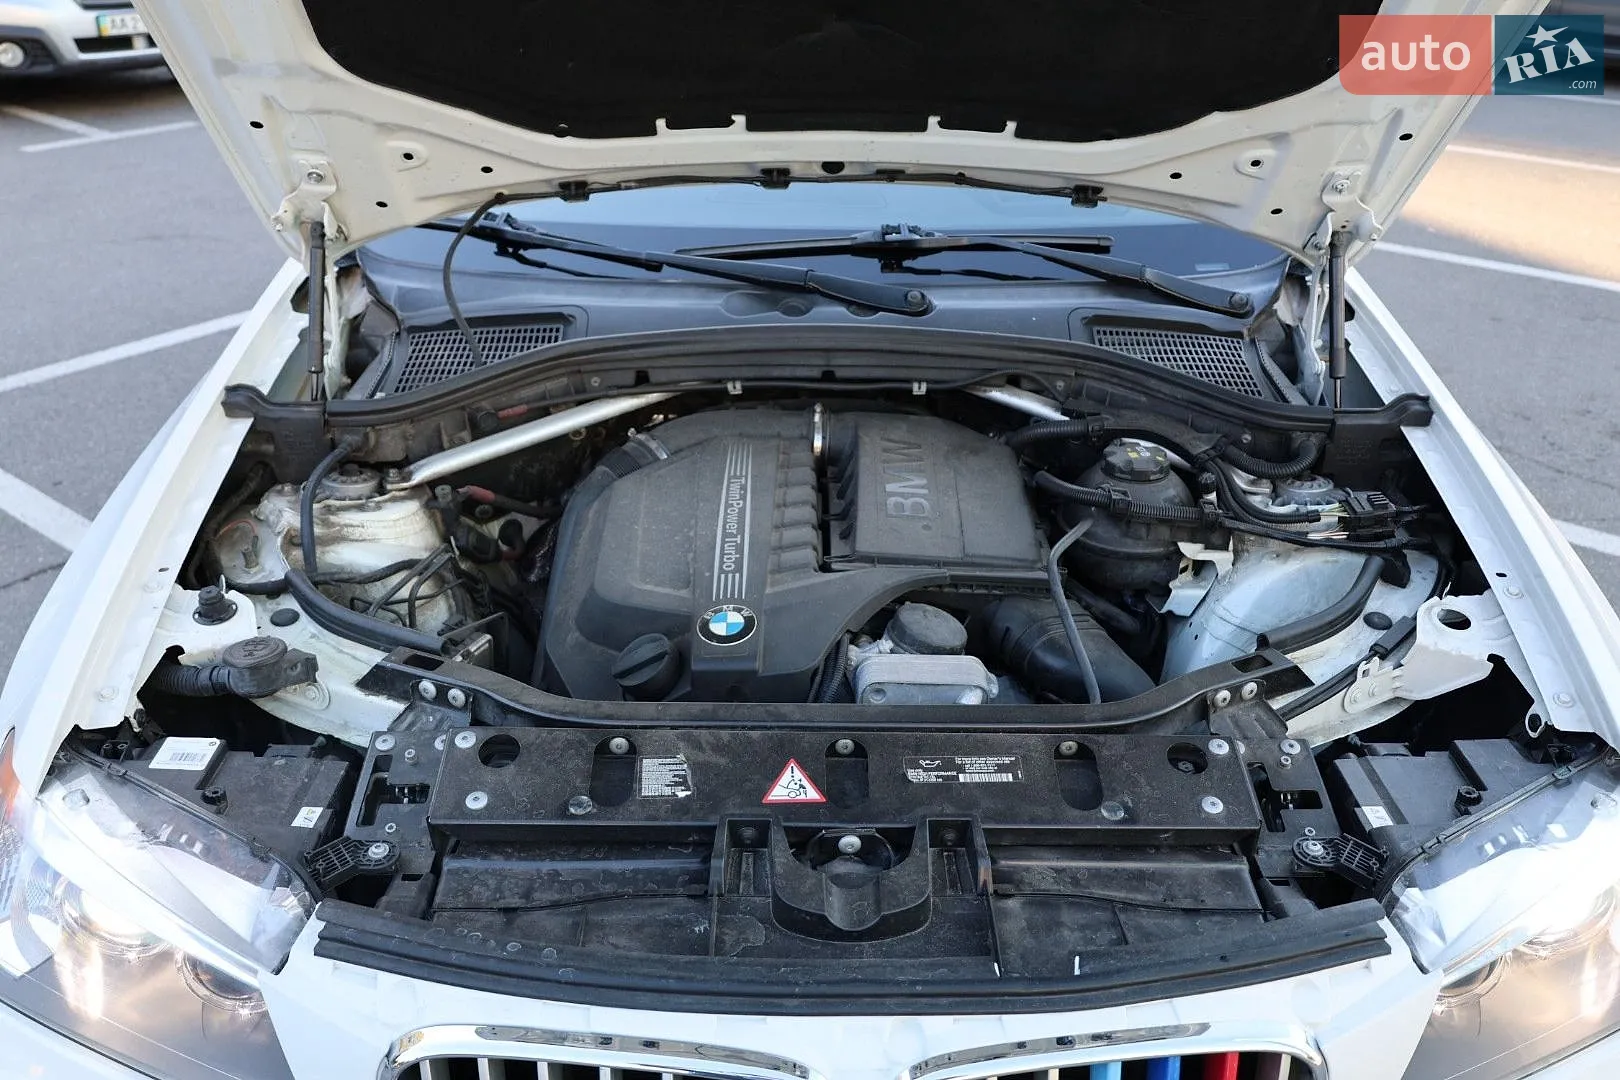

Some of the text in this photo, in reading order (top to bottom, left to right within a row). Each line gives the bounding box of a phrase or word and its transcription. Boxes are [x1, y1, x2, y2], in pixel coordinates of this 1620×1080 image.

[880, 437, 930, 518] BMW
[722, 476, 745, 571] TwinPower Turbo
